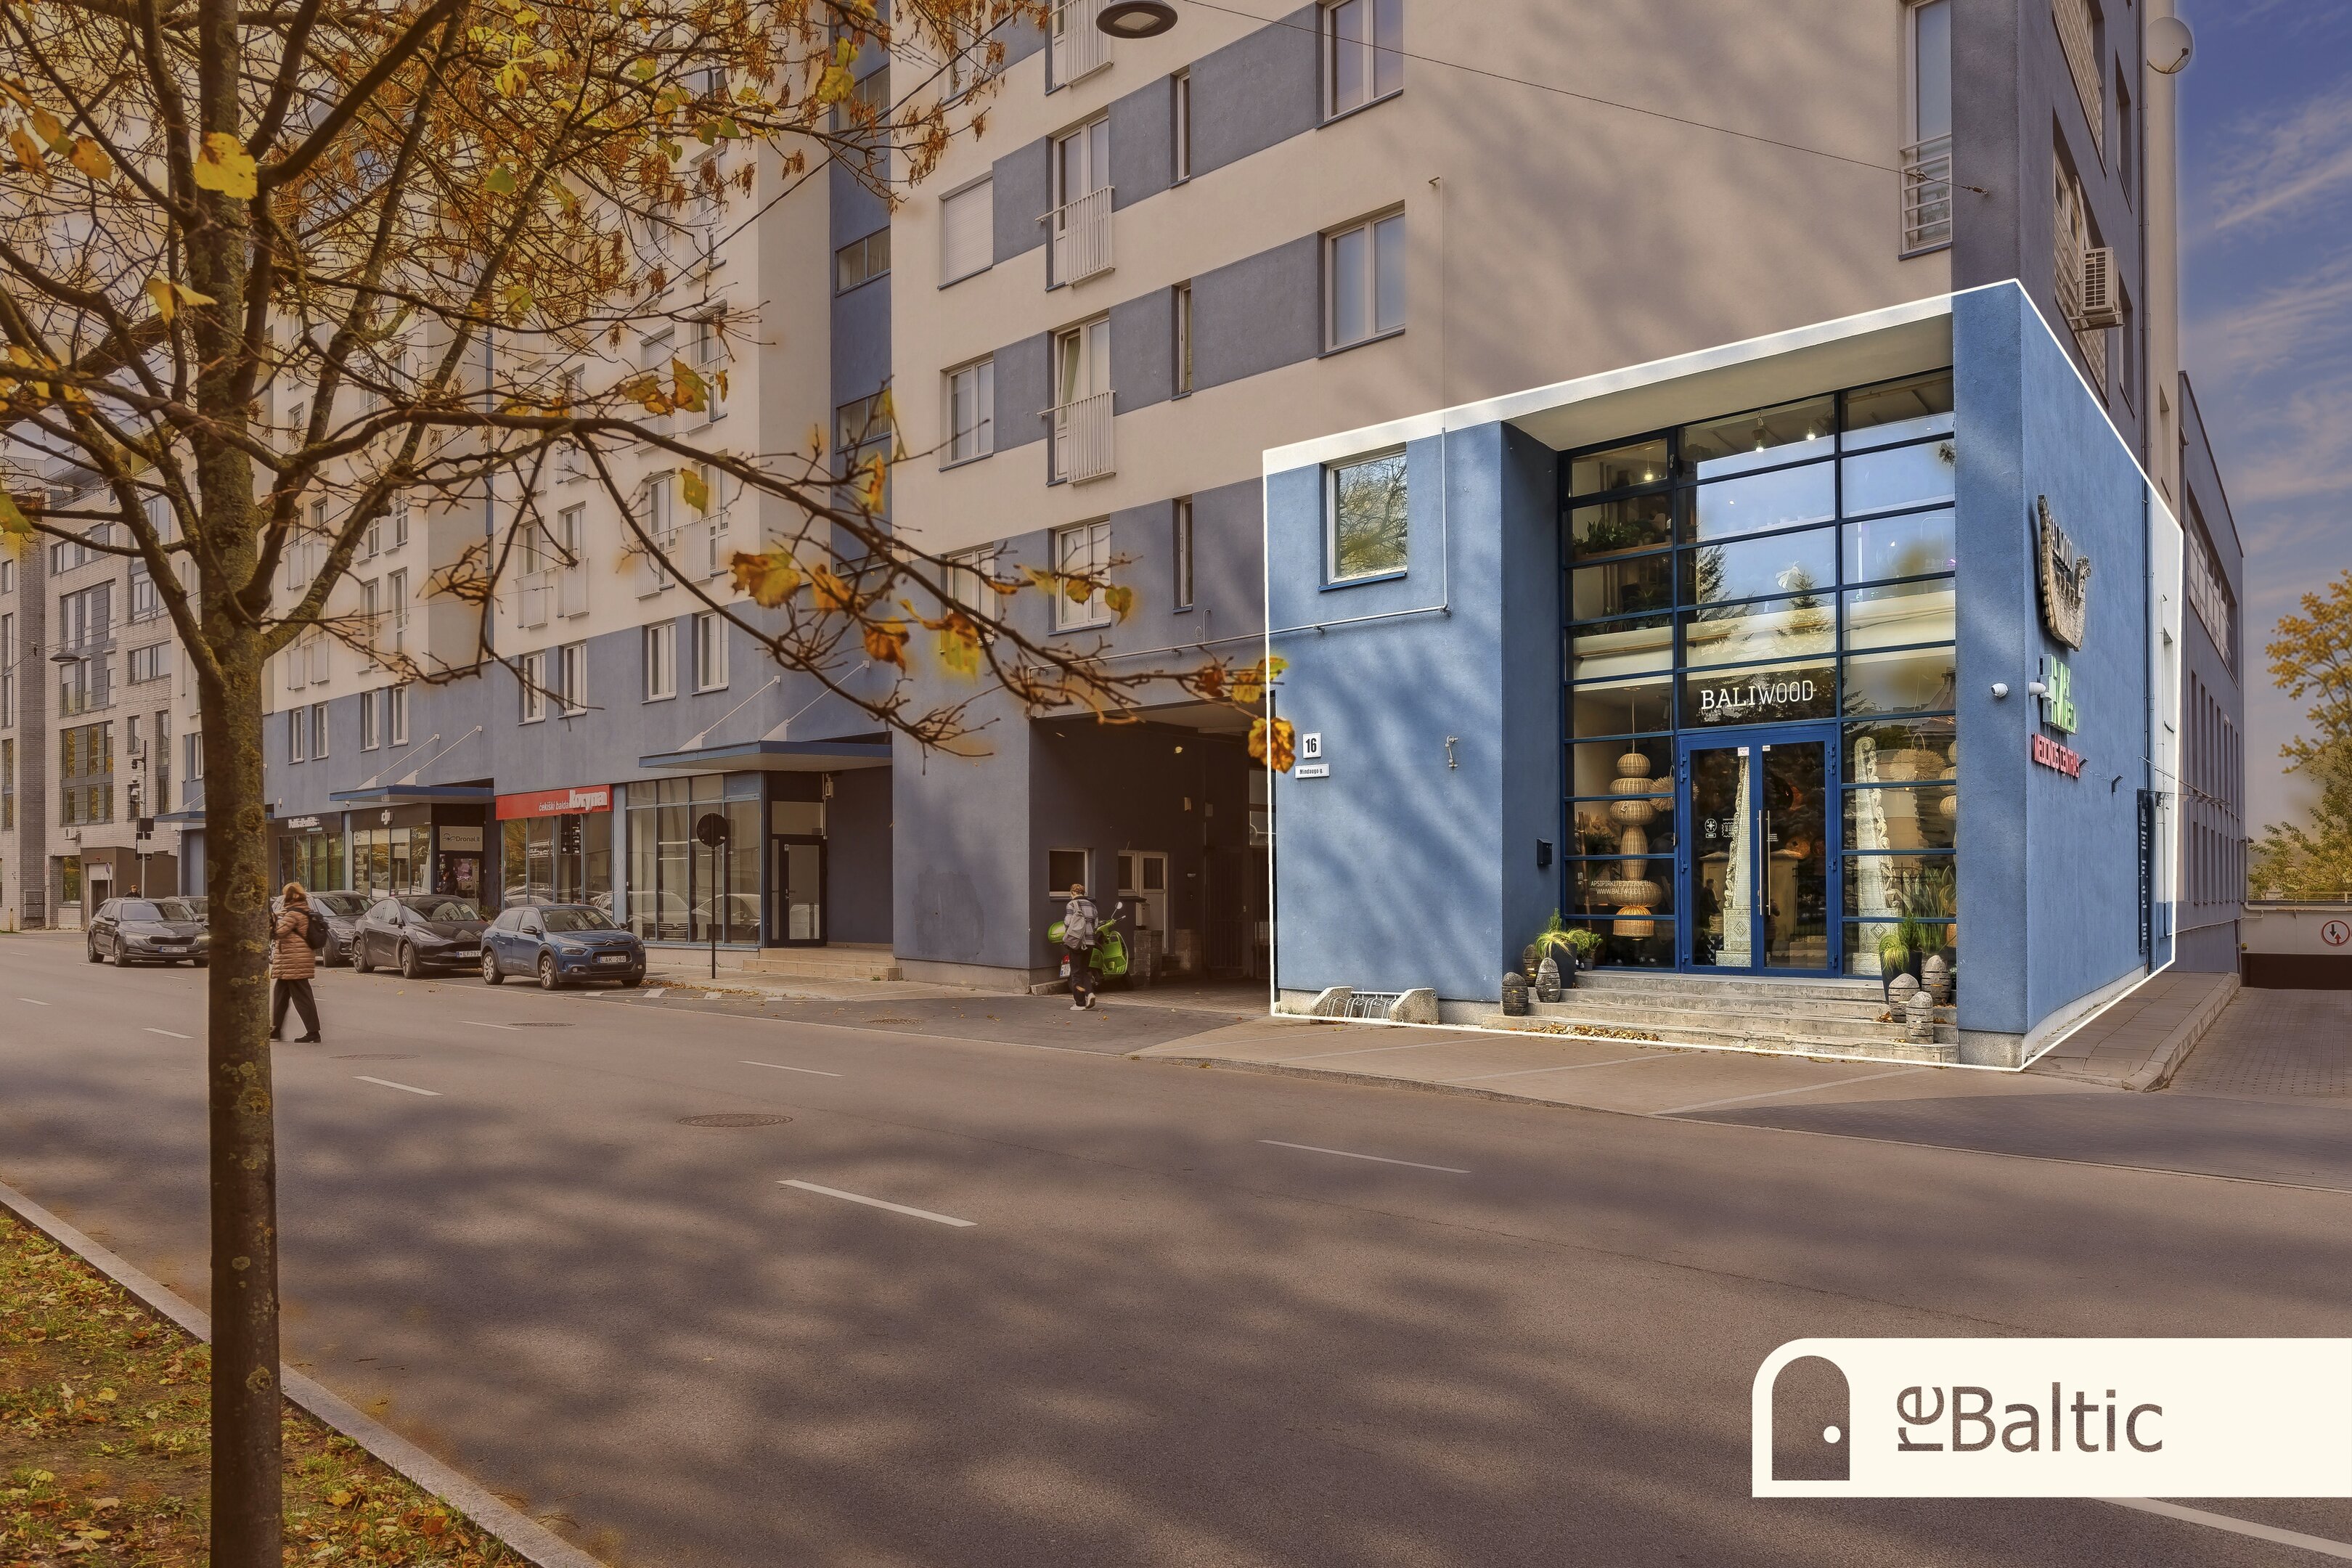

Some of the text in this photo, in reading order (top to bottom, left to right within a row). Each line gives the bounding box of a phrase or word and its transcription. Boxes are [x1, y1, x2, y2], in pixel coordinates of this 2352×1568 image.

[1701, 680, 1814, 710] BALIWOOD
[1305, 738, 1317, 753] 16
[569, 790, 608, 811] koryna
